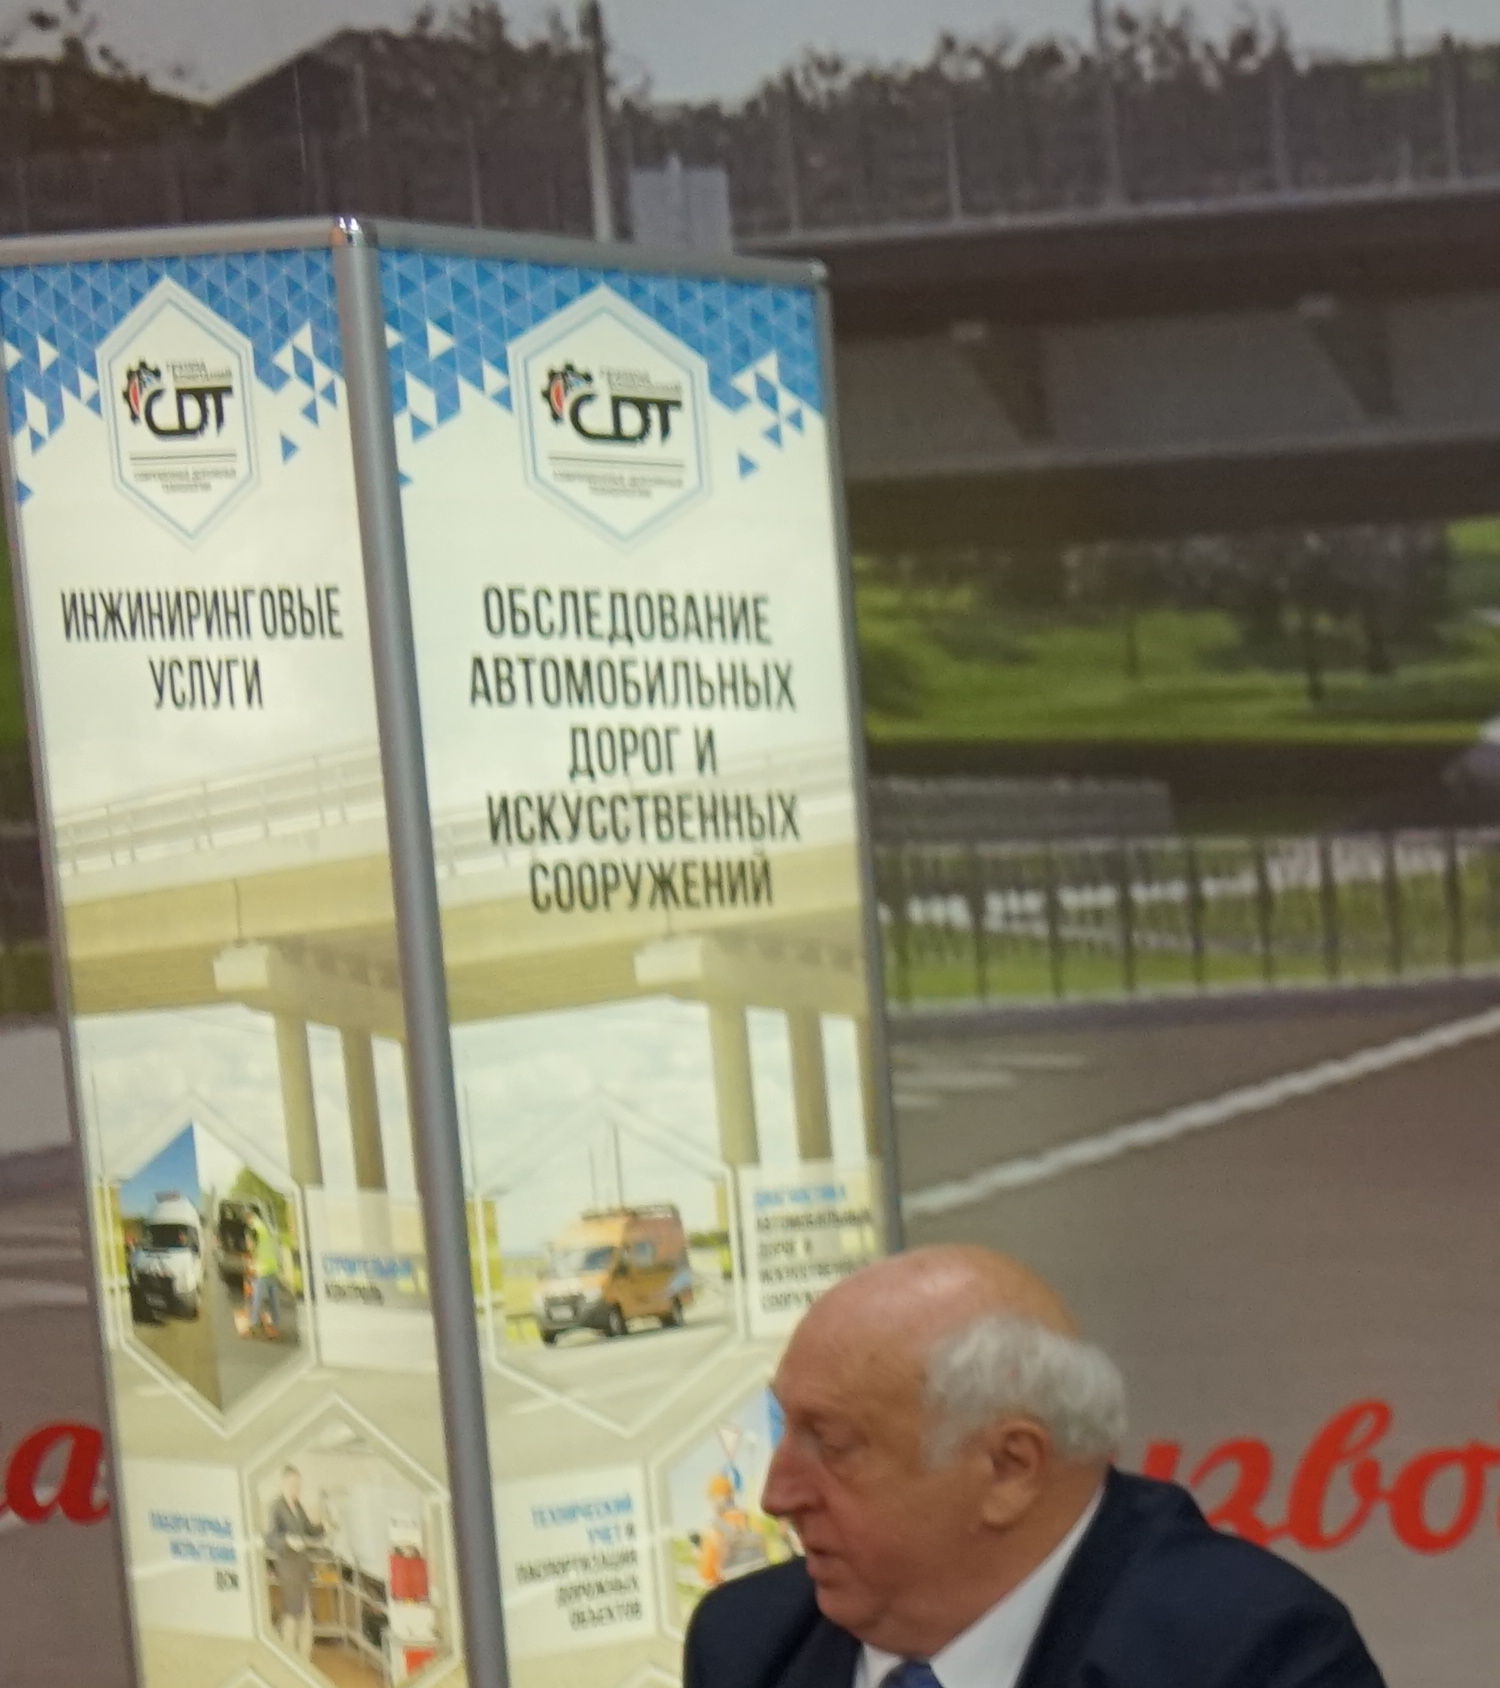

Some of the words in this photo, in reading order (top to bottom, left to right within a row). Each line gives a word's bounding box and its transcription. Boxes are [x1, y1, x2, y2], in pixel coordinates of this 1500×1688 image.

[60, 583, 343, 643] ИНЖИНИРИНГОВЫЕ
[482, 583, 772, 647] ОБСЛЕДОВАНИЕ
[148, 657, 264, 711] УСЛУГИ
[469, 654, 797, 710] АВТОМОБИЛЬНЫХ
[568, 726, 676, 781] ДОРОГ
[693, 726, 717, 772] И
[487, 790, 800, 845] ИСКУССТВЕННЫХ
[529, 846, 774, 913] СООРУЖЕНИЙ
